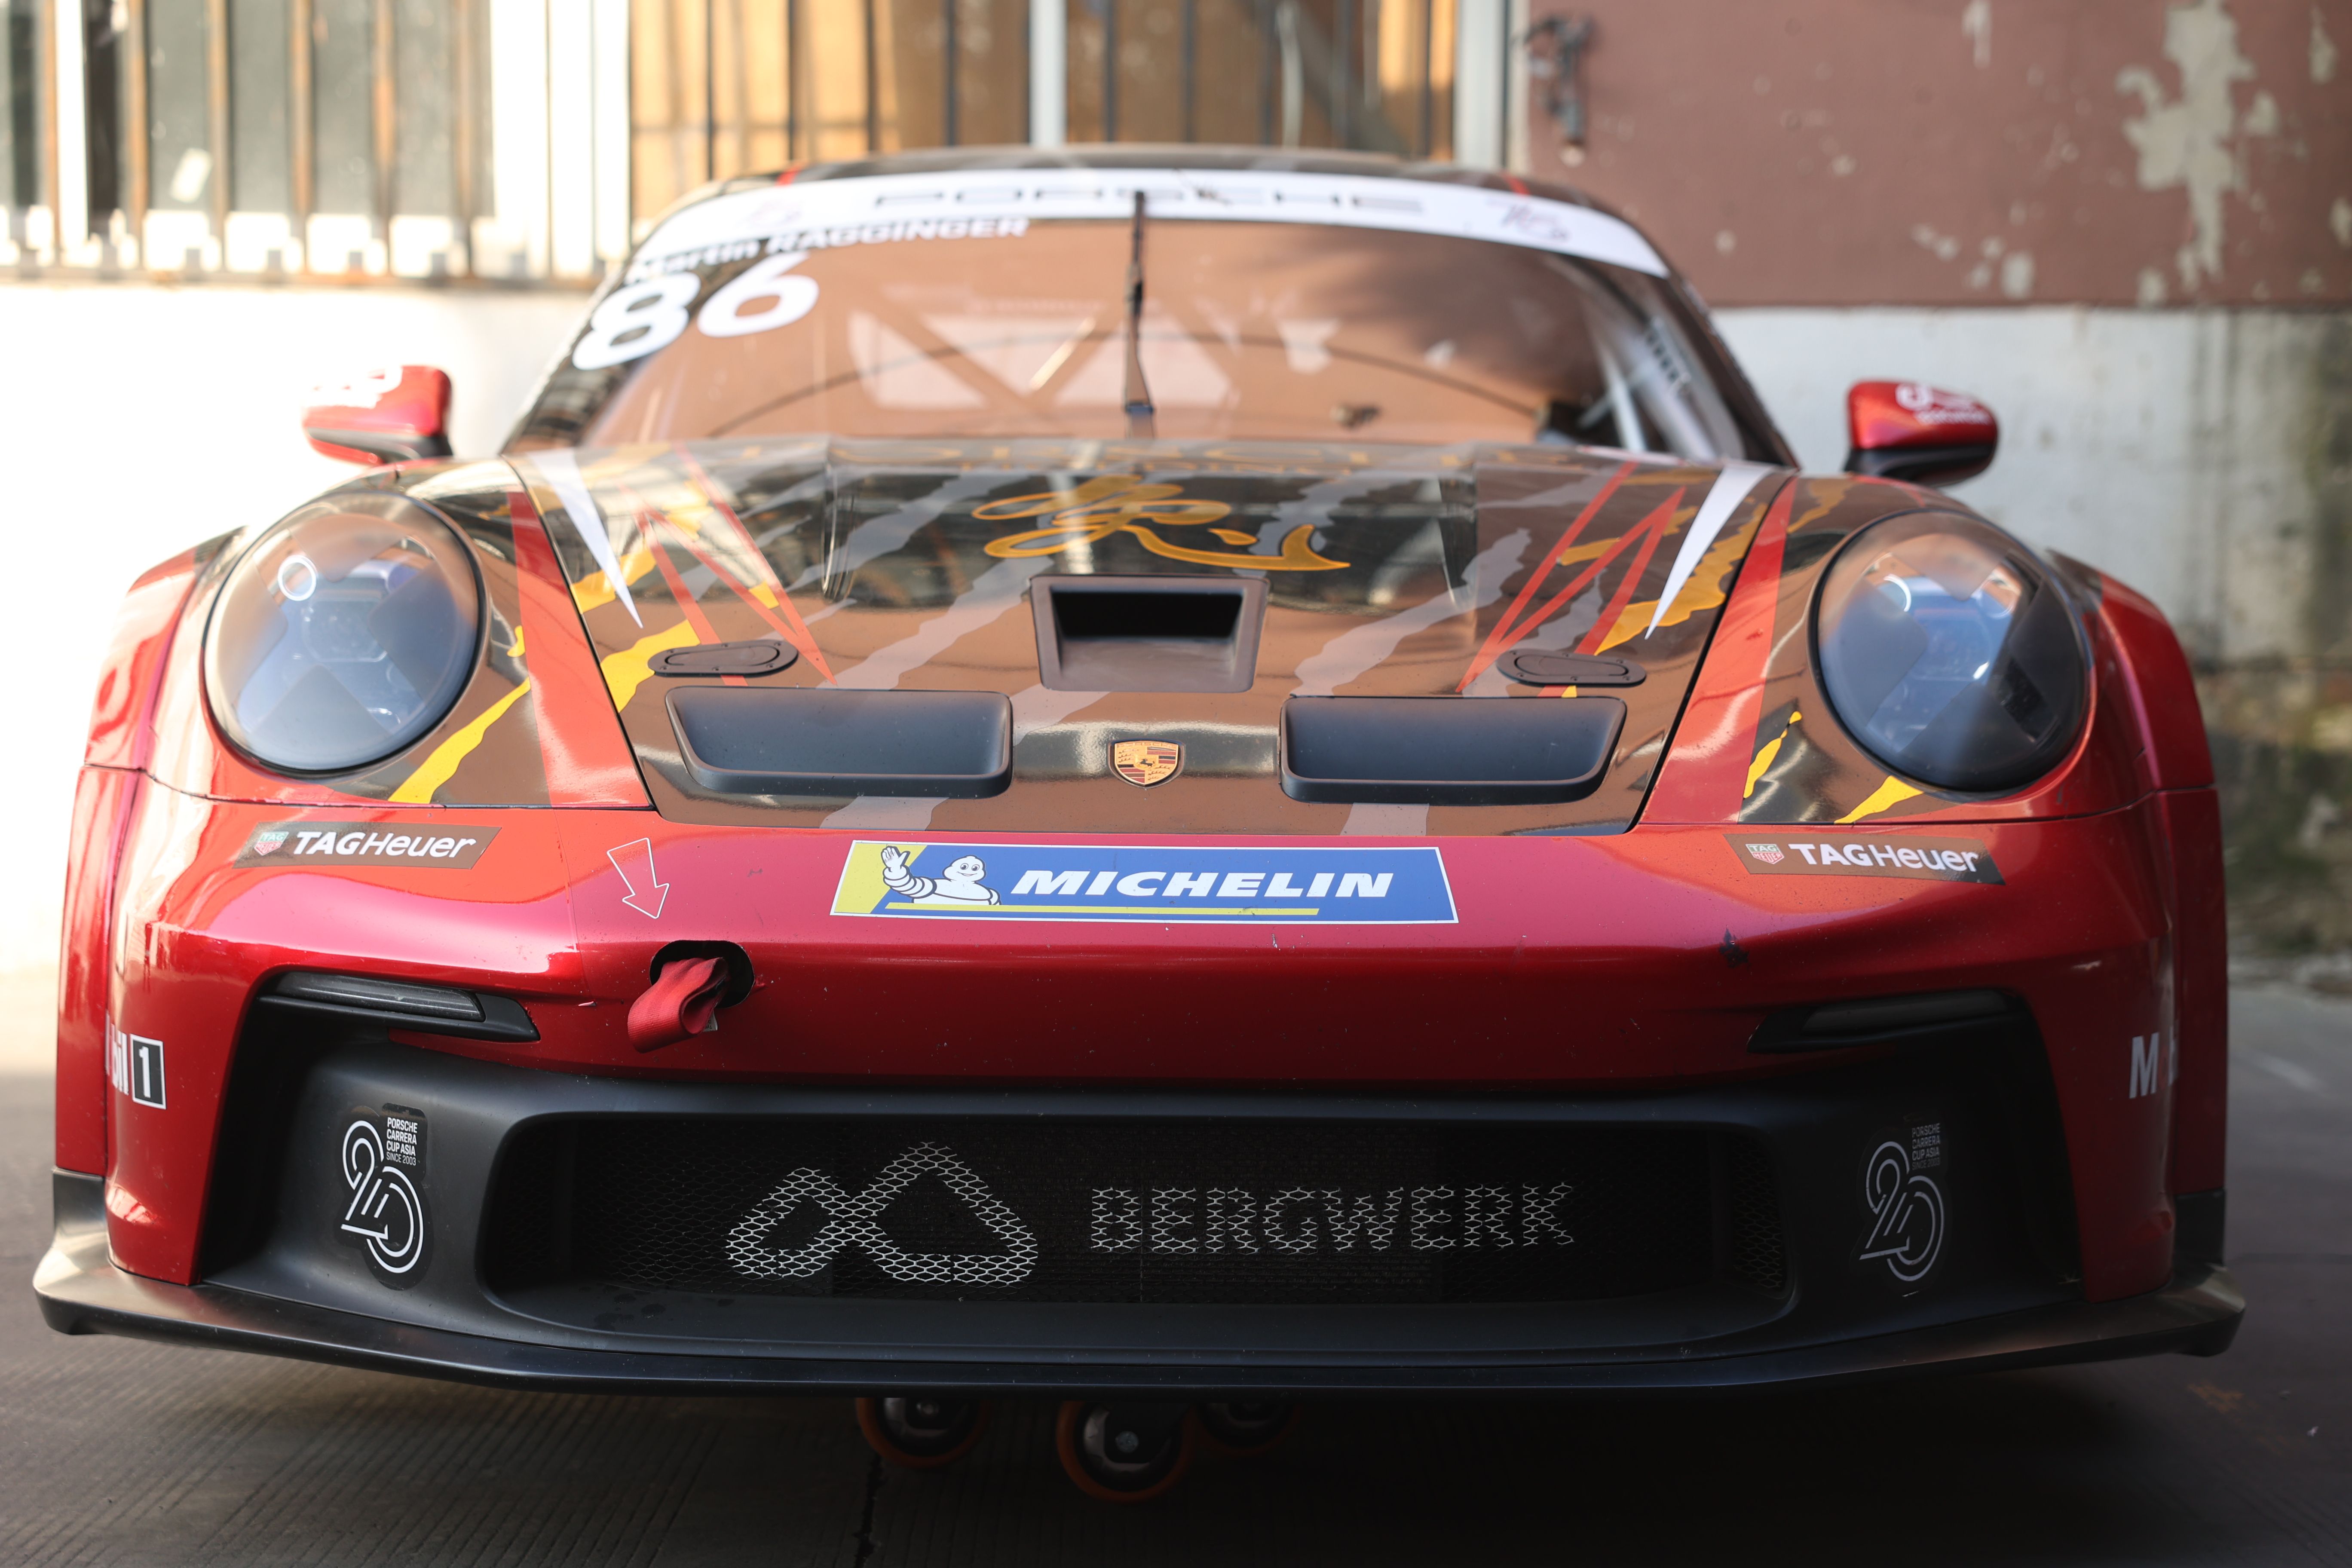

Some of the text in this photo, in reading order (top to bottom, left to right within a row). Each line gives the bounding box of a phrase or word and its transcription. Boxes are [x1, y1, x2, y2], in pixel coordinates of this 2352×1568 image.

[766, 216, 1030, 256] RAGGINGER
[572, 251, 819, 371] 86
[260, 833, 285, 841] TAG
[1753, 853, 1781, 862] HEUER
[1011, 869, 1394, 898] MICHELIN
[387, 1117, 418, 1133] PORSCHE
[1911, 1122, 1941, 1138] PORSCHE
[387, 1128, 417, 1145] CARRERA
[1912, 1135, 1941, 1149] CARRERA
[386, 1140, 416, 1157] CUP ASIA
[1912, 1146, 1940, 1161] CUP ASIA
[386, 1151, 416, 1166] SINCE 2003
[1091, 1181, 1576, 1255] BERGWERK
